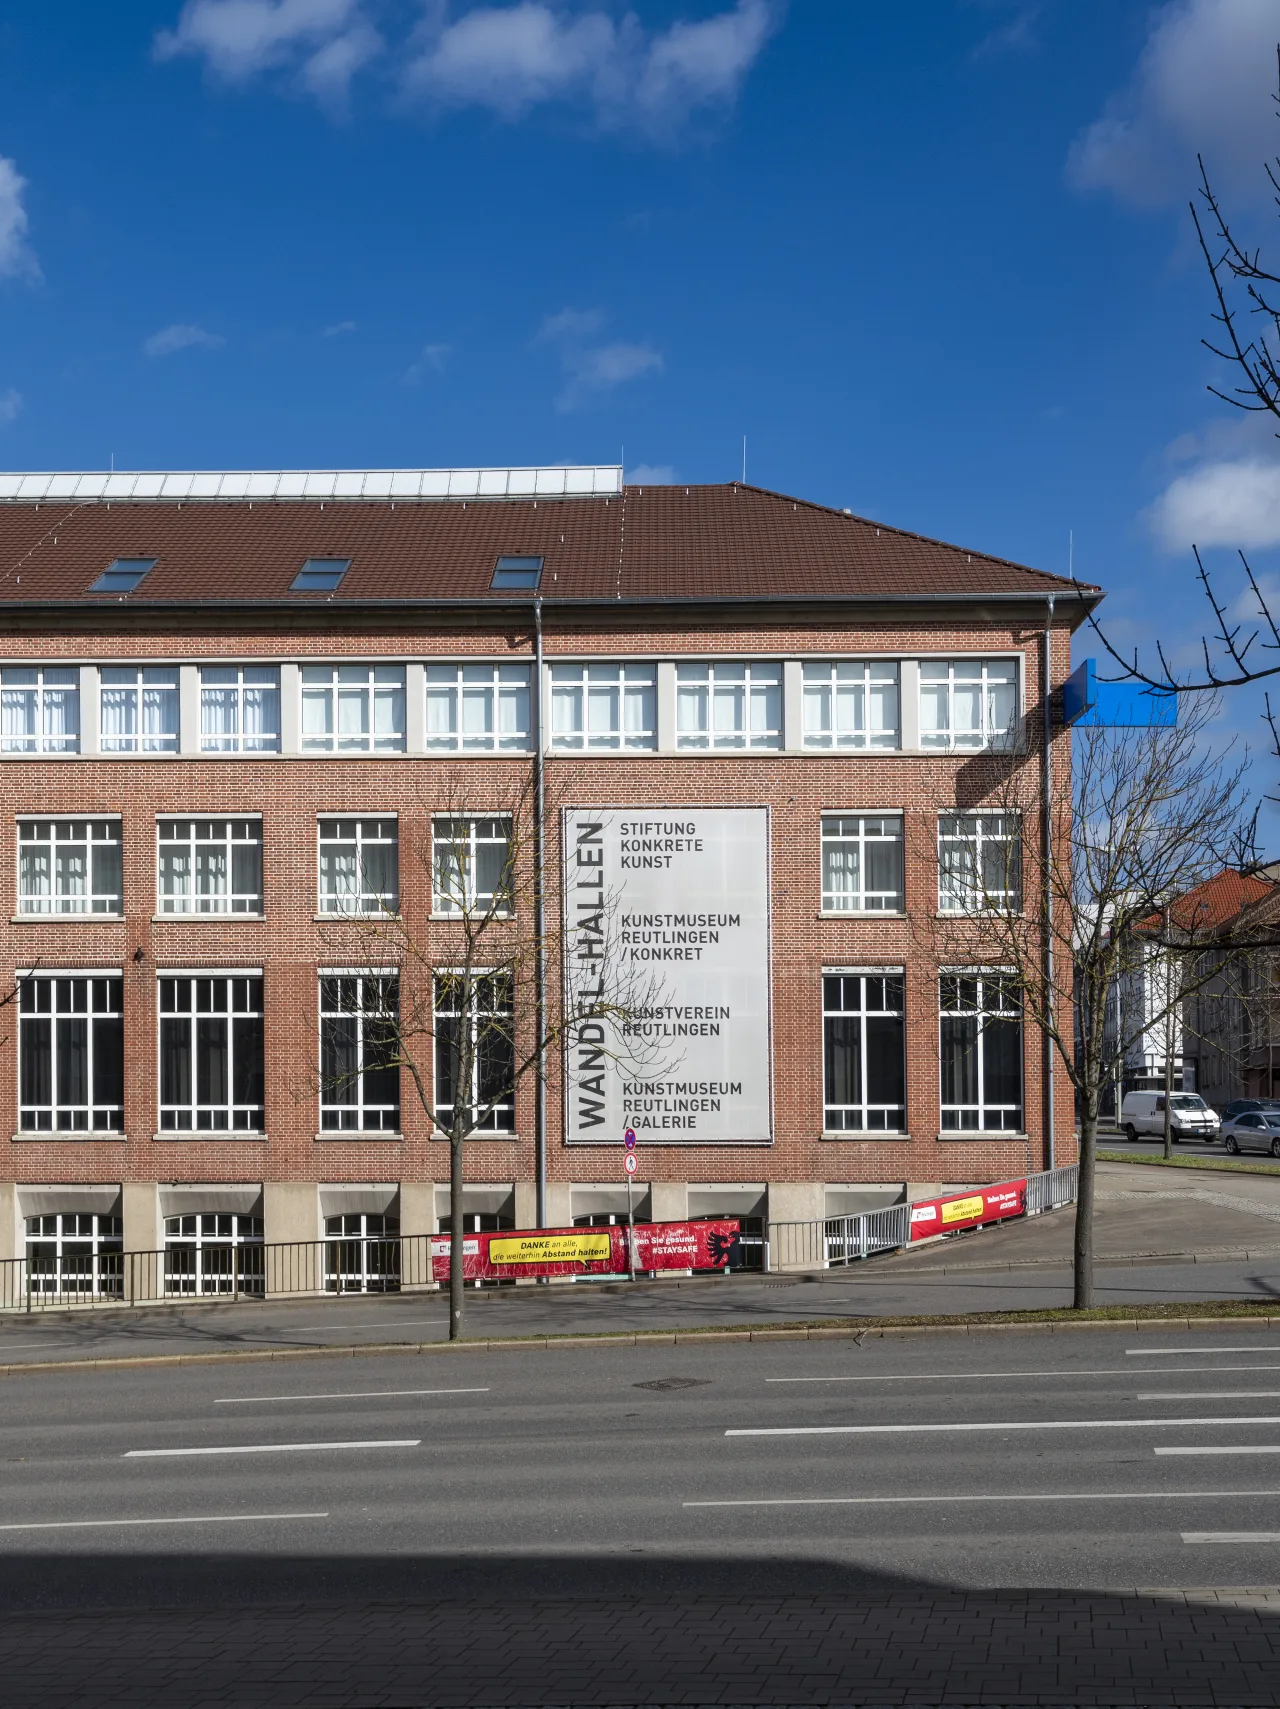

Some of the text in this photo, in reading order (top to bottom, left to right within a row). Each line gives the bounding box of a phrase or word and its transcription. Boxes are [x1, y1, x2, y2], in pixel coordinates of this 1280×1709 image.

[620, 823, 696, 835] STIFTUNG
[621, 839, 703, 852] KONKRETE
[621, 856, 673, 868] KUNST
[621, 914, 740, 927] KUNSTMUSEUM
[622, 931, 719, 944] REUTLINGEN
[577, 823, 605, 1130] WANDEL-HALLEN
[623, 1023, 720, 1036] REUTLINGEN
[623, 1082, 742, 1095] KUNSTMUSEUM
[623, 1099, 720, 1112] REUTLINGEN
[520, 1241, 550, 1250] DANKE
[651, 1236, 664, 1244] Sie
[665, 1235, 698, 1245] gesund.
[506, 1252, 540, 1260] weiterhin
[542, 1249, 576, 1258] Abstand
[578, 1247, 607, 1256] halten!
[652, 1245, 698, 1254] #STAYSAFE
